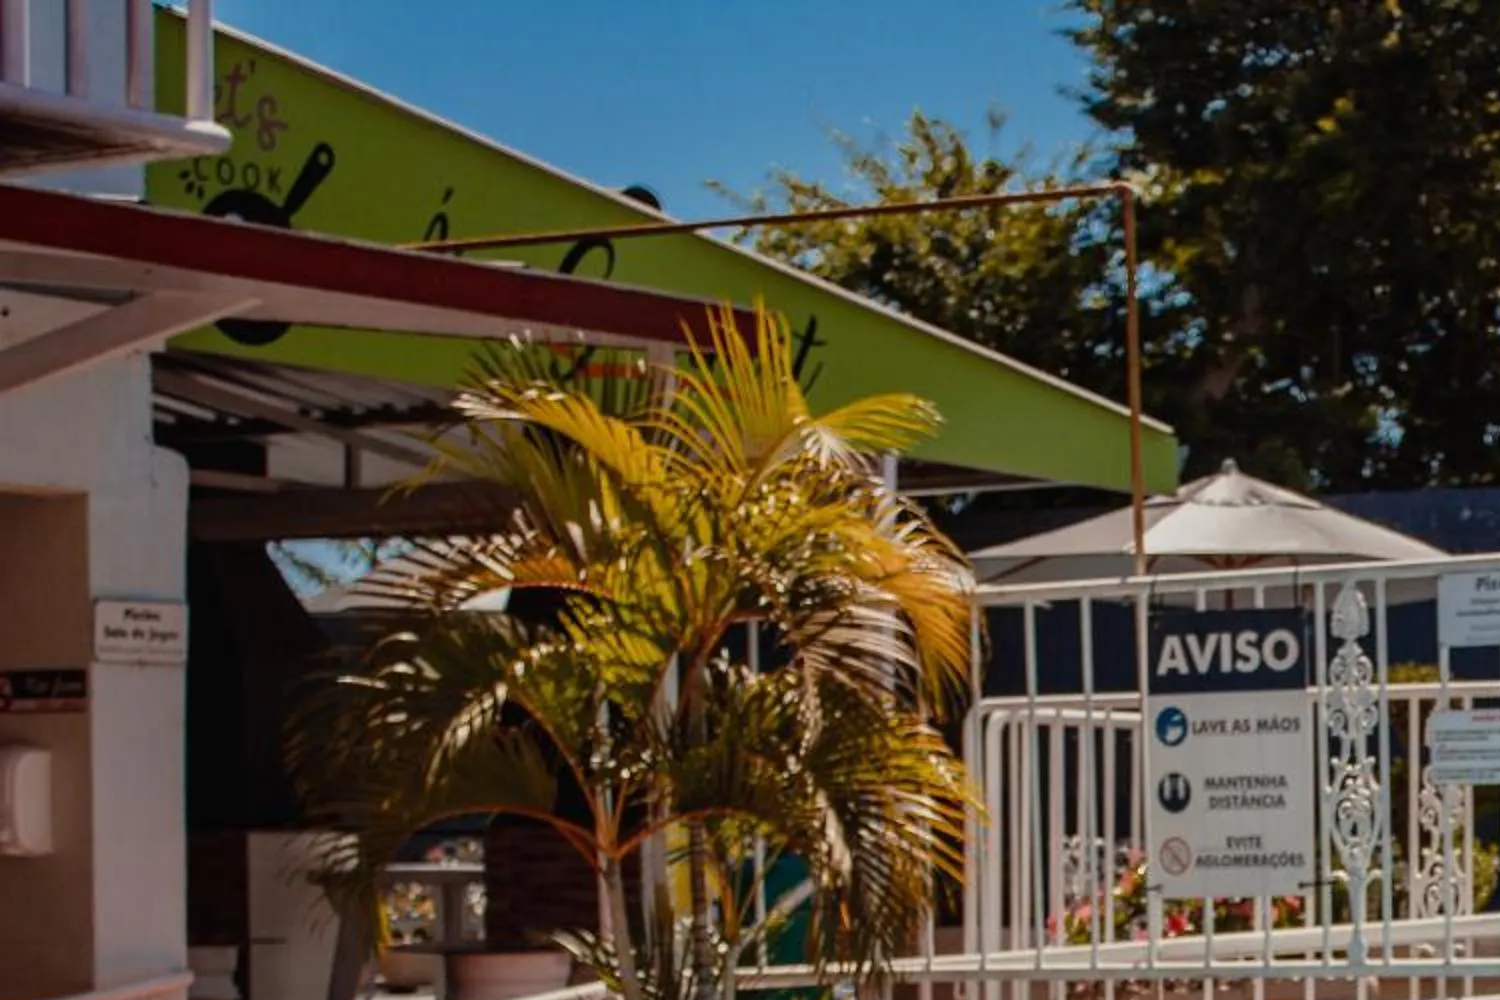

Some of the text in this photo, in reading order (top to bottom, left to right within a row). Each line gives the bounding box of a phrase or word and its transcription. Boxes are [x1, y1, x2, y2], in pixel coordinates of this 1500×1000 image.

[193, 156, 283, 196] COOK
[1156, 628, 1300, 677] AVISO
[1191, 719, 1227, 736] LAVE
[1230, 718, 1252, 734] AS
[1203, 775, 1289, 790] MANTENHA
[1225, 835, 1264, 849] EVITE
